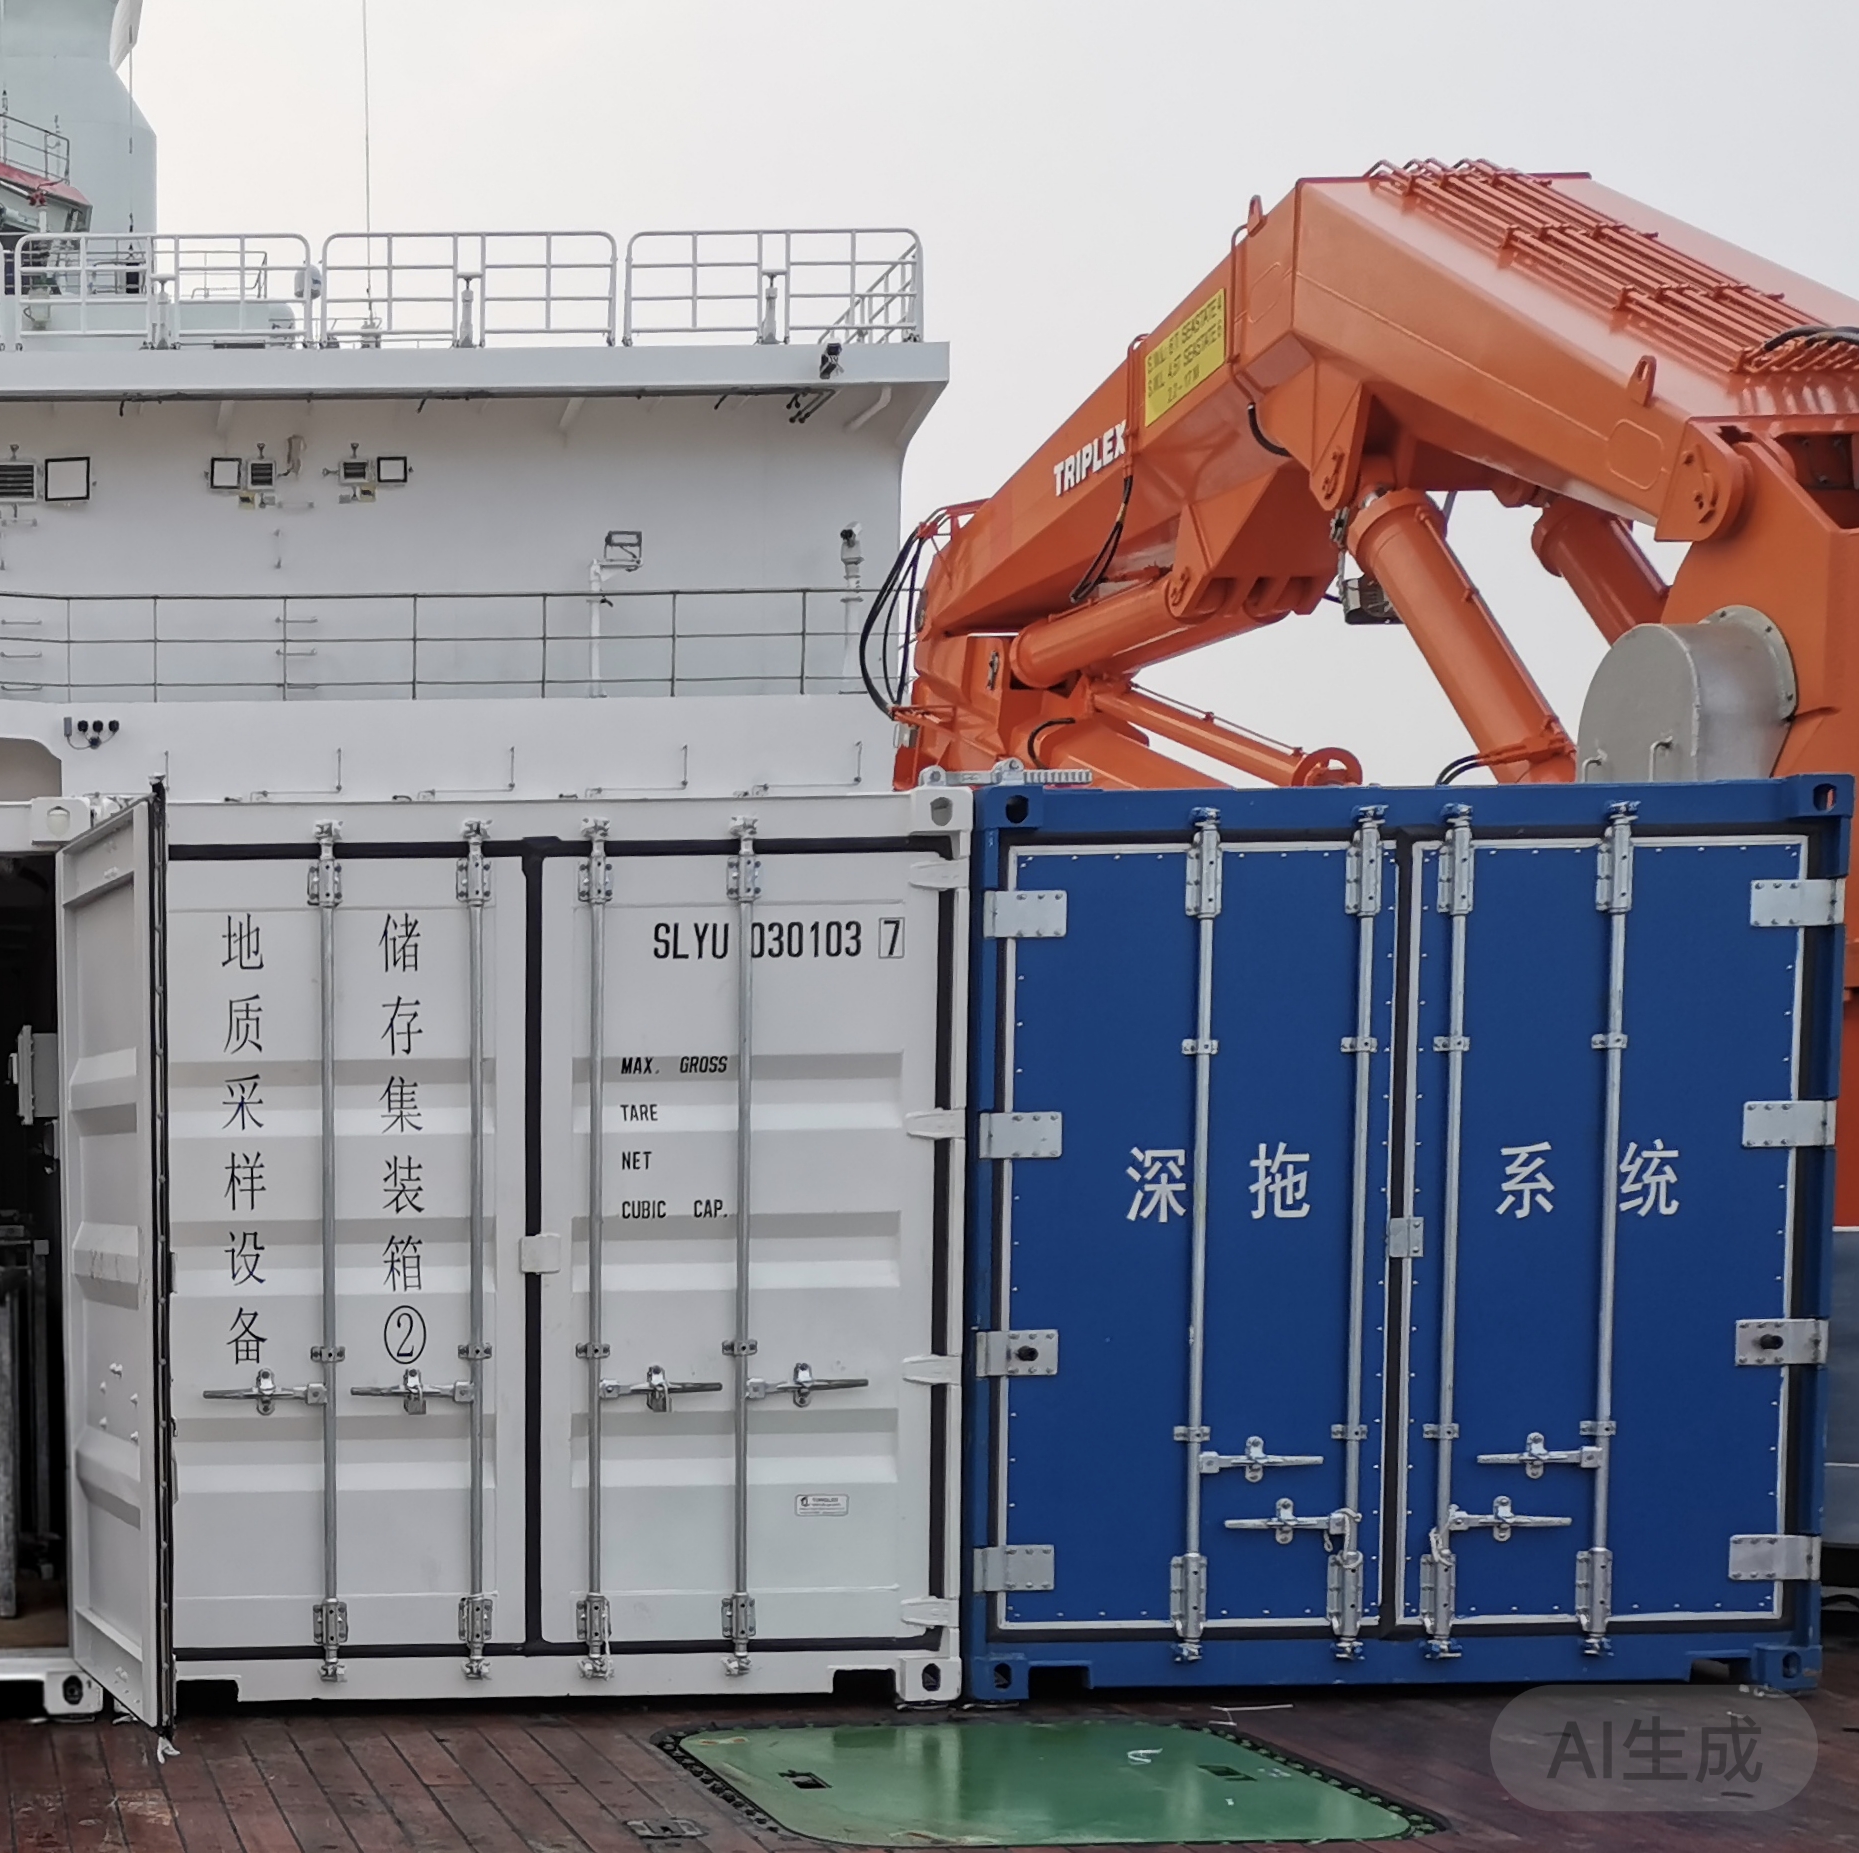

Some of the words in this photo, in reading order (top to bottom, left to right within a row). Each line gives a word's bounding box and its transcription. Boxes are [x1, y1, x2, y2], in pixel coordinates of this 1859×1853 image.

[1053, 419, 1126, 496] TRIPLEX
[653, 922, 730, 960] SLYU
[750, 920, 863, 959] 030103
[882, 919, 901, 957] 7
[621, 1056, 661, 1075] MAX.
[679, 1056, 728, 1074] GROSS
[620, 1104, 658, 1122] TARE
[221, 912, 268, 1366] 地质采样设备
[622, 1151, 653, 1171] NET
[622, 1200, 667, 1220] CUBIC
[694, 1199, 729, 1219] CAP.
